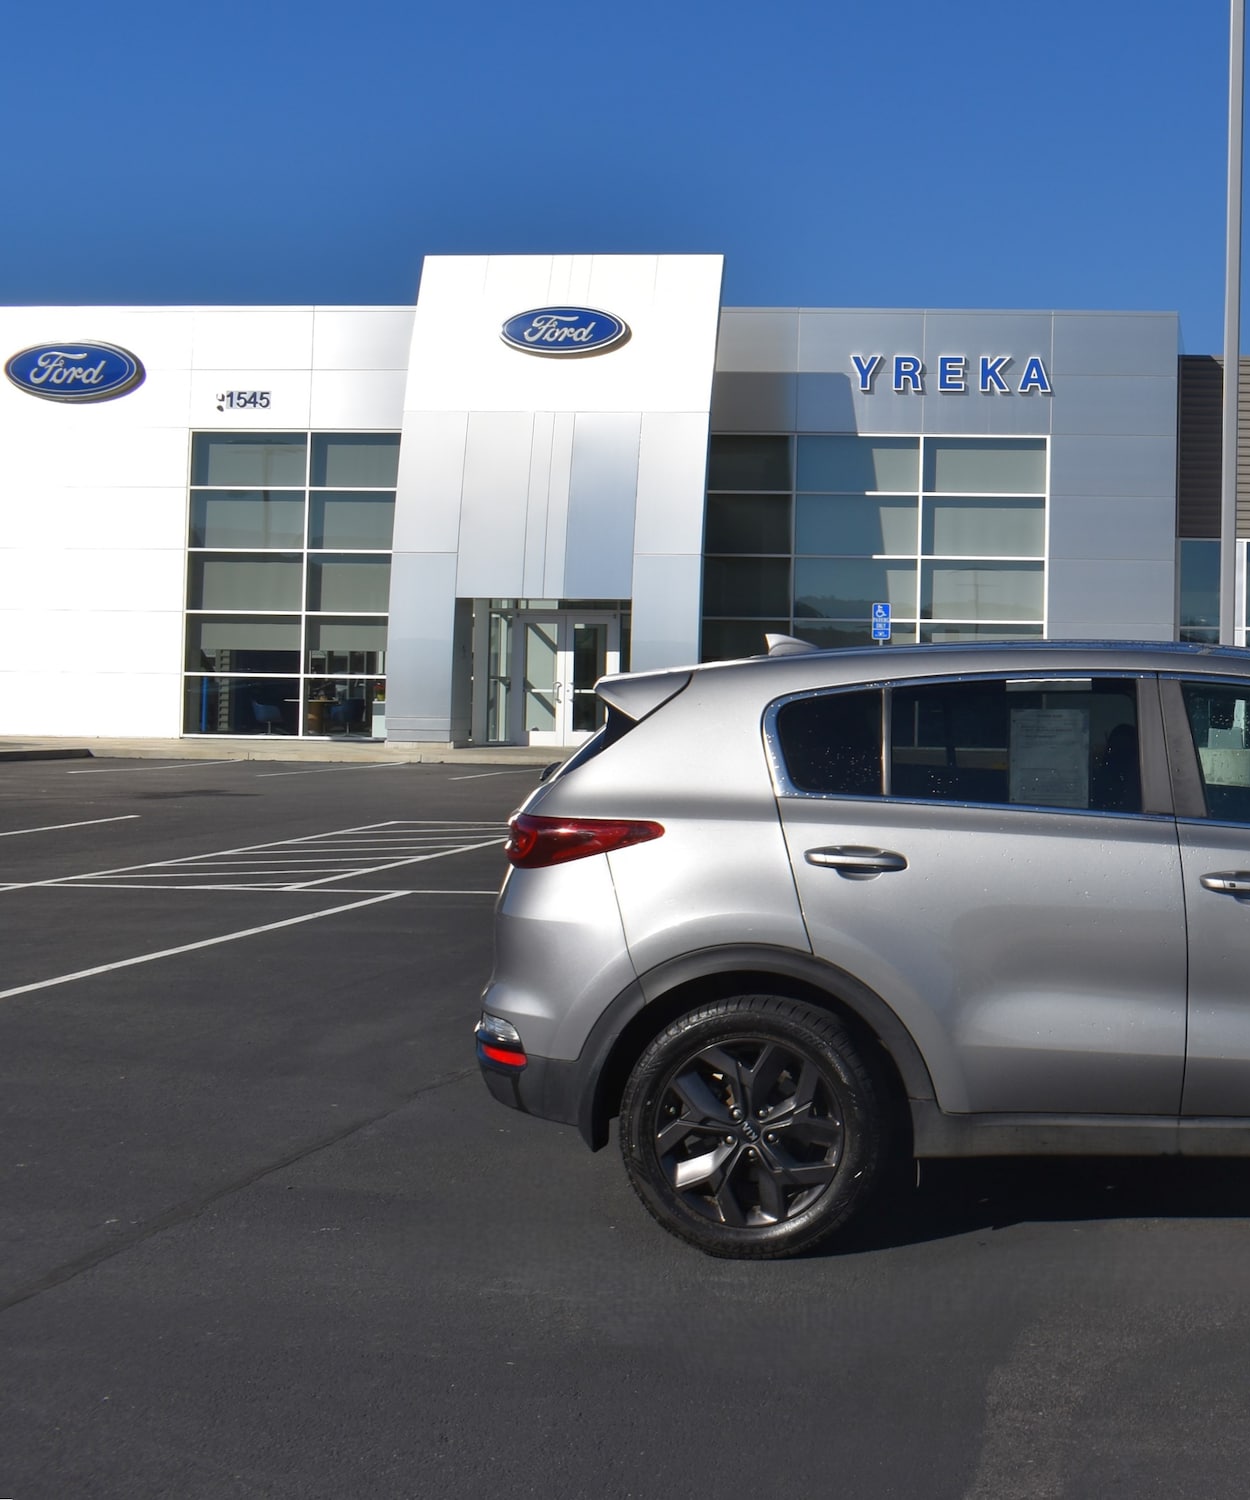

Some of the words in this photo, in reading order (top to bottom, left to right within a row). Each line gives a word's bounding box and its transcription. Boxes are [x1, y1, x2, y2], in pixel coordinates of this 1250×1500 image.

[524, 315, 596, 342] Ford
[30, 351, 106, 384] Ford
[850, 355, 1051, 393] YREKA
[226, 391, 270, 408] 1545
